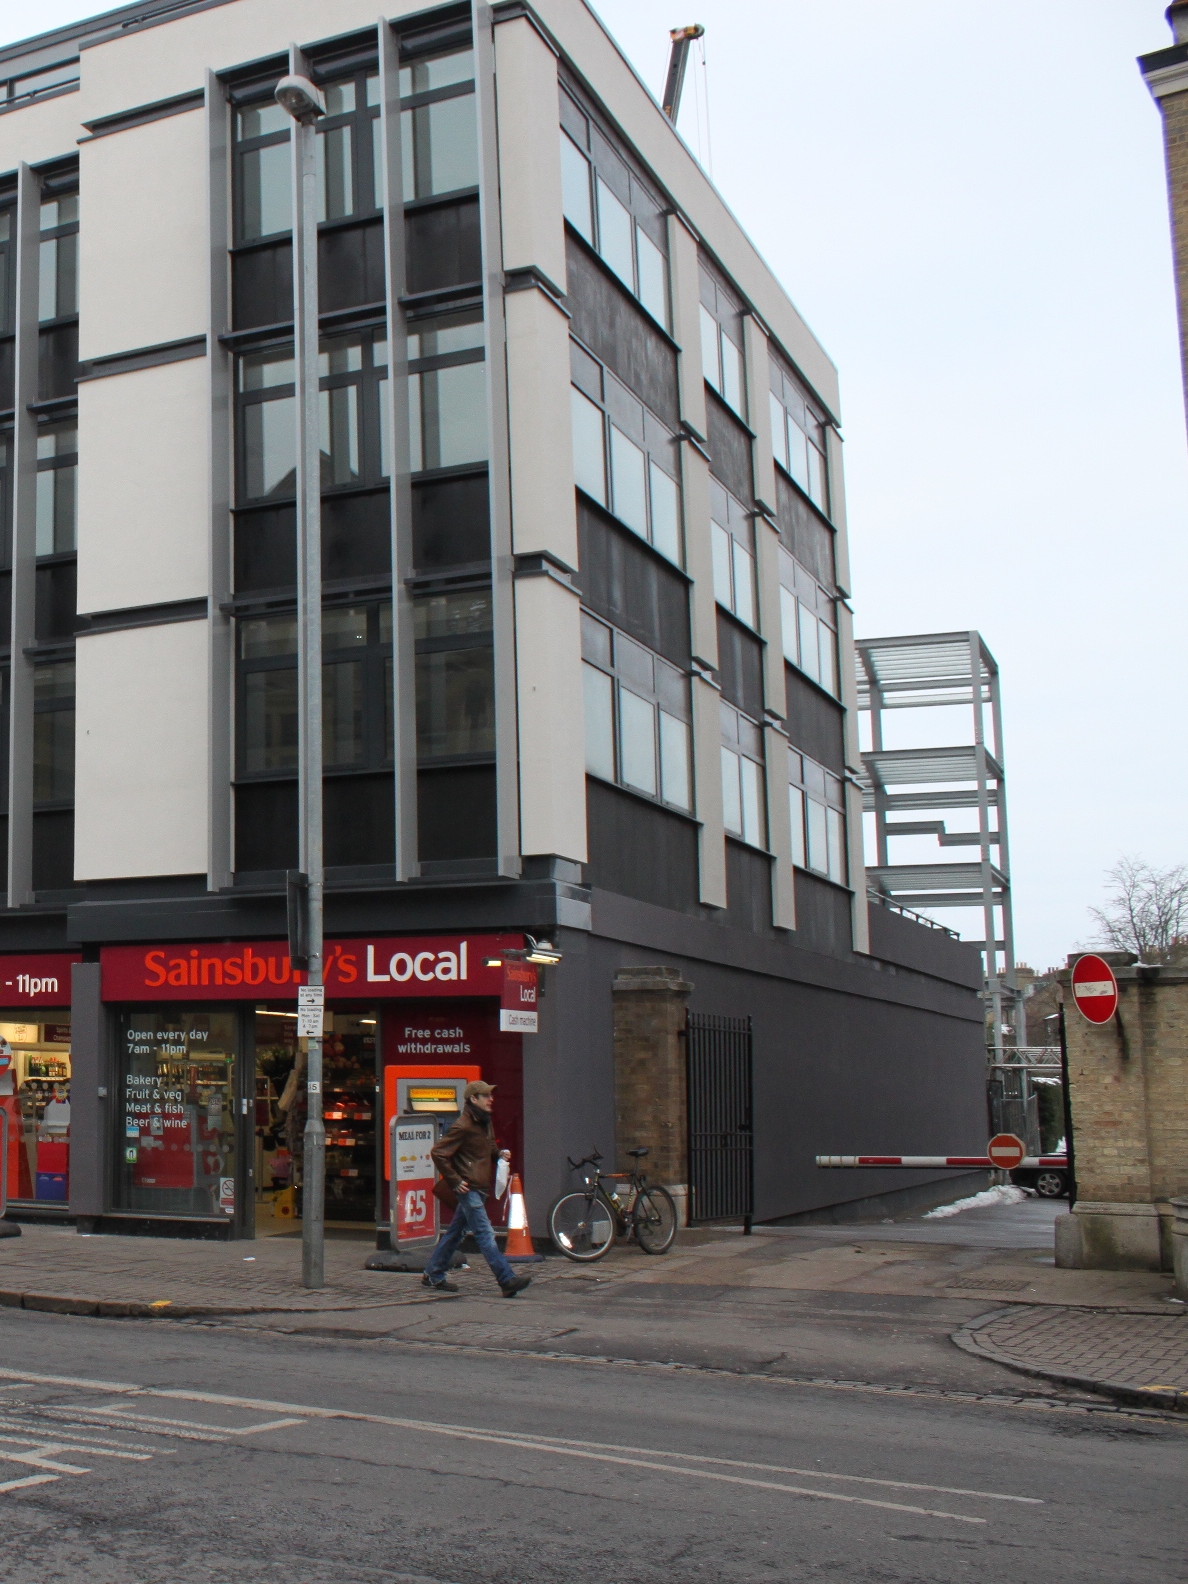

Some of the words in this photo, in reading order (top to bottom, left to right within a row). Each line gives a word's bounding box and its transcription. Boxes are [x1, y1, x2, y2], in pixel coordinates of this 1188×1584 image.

[366, 940, 468, 982] Local
[16, 974, 58, 997] 11pm
[520, 984, 536, 1002] Local
[508, 1014, 518, 1025] Cash
[519, 1016, 537, 1027] machine
[127, 1029, 154, 1041] Open
[156, 1031, 186, 1042] every
[189, 1029, 209, 1042] day
[404, 1027, 431, 1038] Free
[434, 1026, 463, 1038] cash
[127, 1043, 150, 1054] 7am
[161, 1043, 187, 1055] 11pm
[397, 1042, 471, 1053] withdrawals
[126, 1075, 162, 1087] Bakery
[126, 1088, 149, 1099] Fruit
[152, 1088, 161, 1099] &
[163, 1090, 182, 1102] veg
[125, 1103, 151, 1113] Meat
[154, 1103, 162, 1113] &
[165, 1102, 184, 1113] fish
[125, 1116, 150, 1127] Beer
[152, 1117, 161, 1128] &
[163, 1117, 187, 1128] wine
[399, 1131, 415, 1140] MEAL
[415, 1130, 427, 1140] FOR
[404, 1190, 427, 1223] £5
